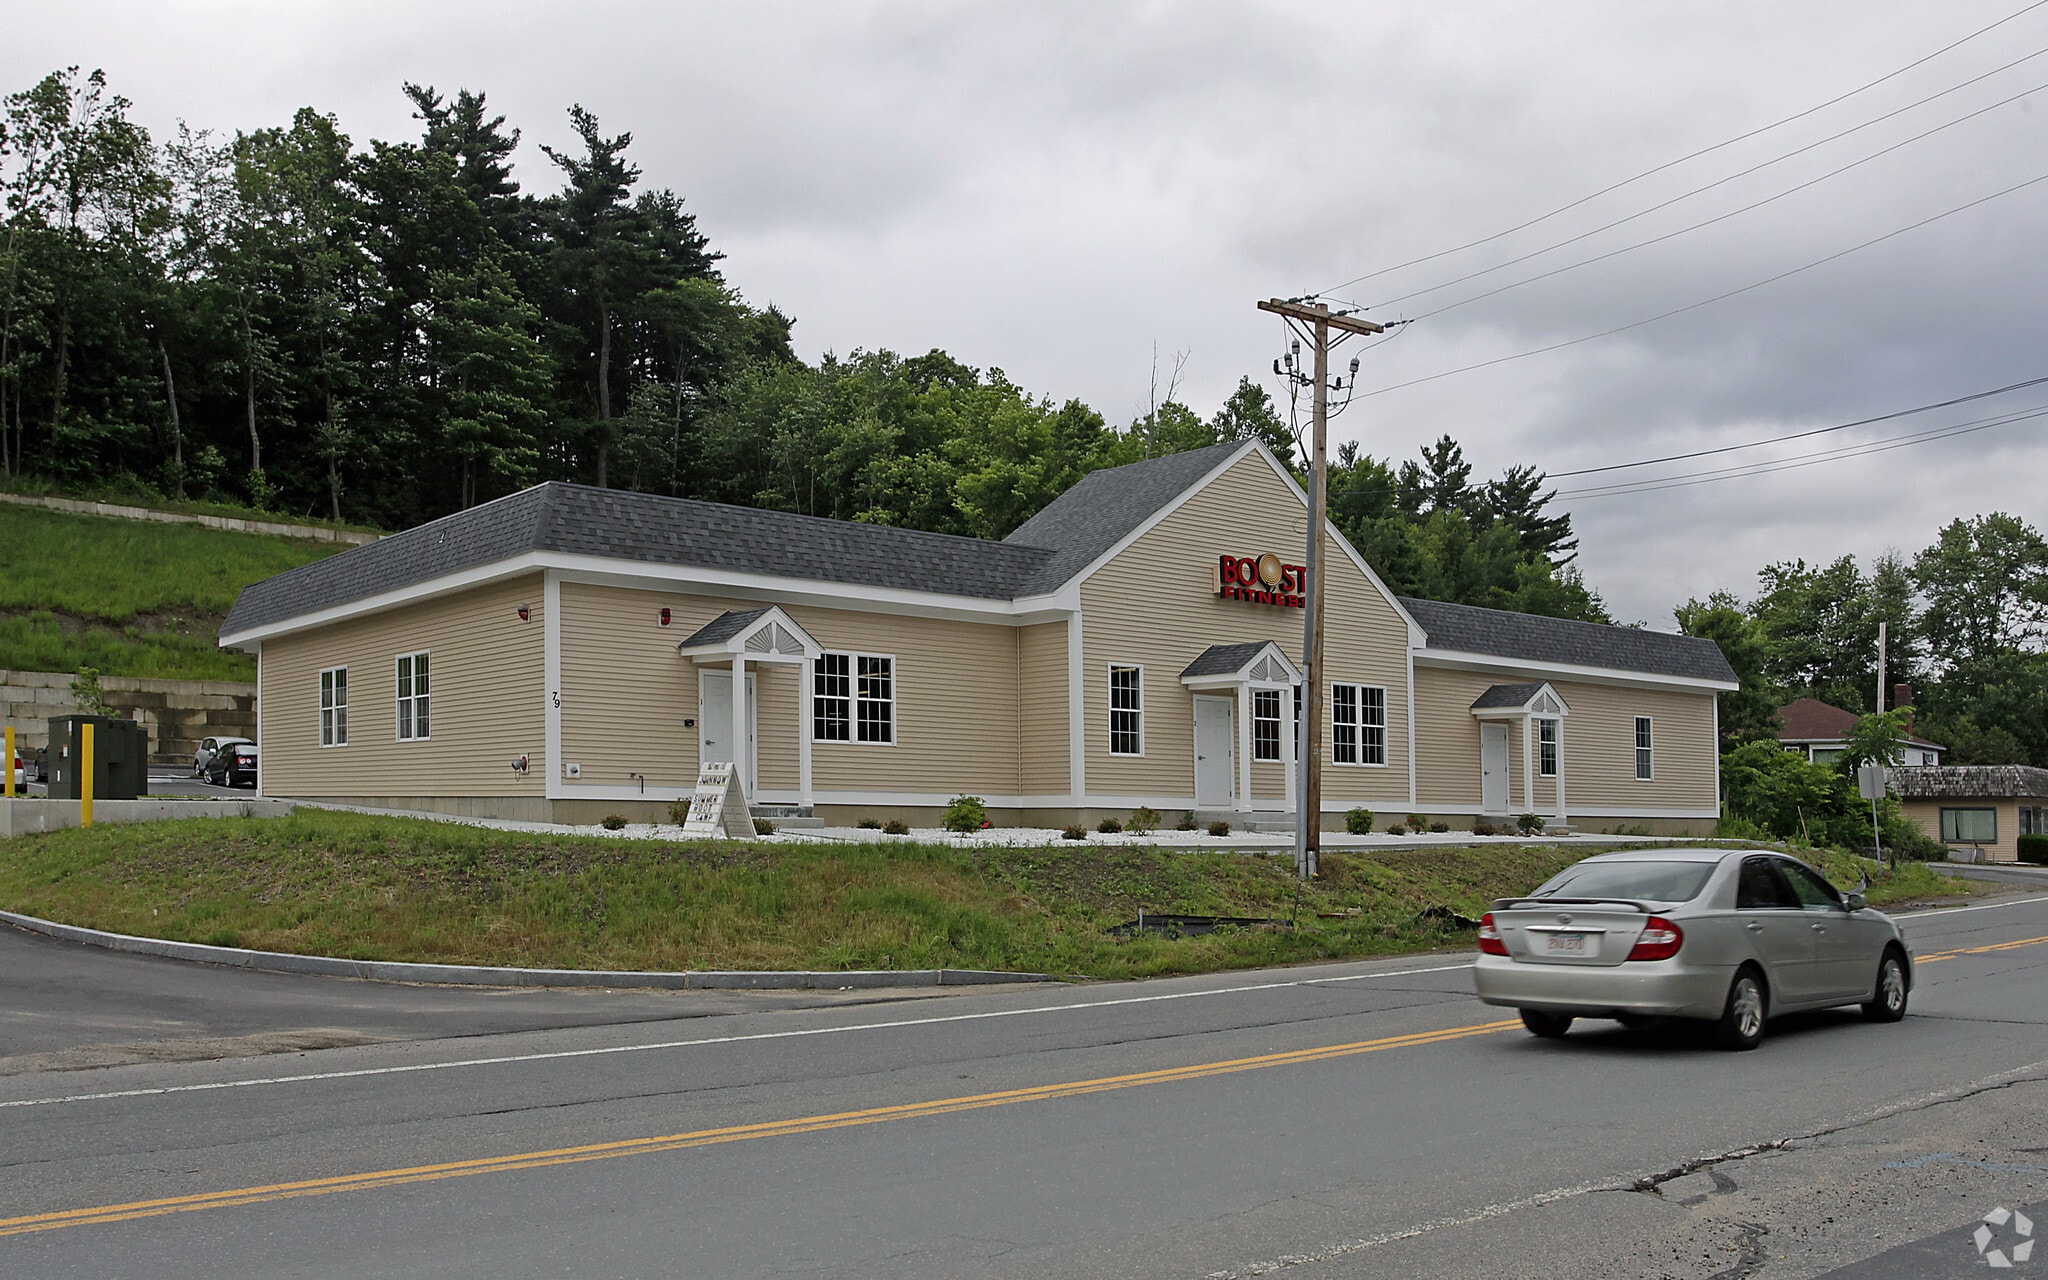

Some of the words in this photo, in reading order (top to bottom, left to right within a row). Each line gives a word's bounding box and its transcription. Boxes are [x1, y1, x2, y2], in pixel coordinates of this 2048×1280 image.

[1220, 552, 1307, 593] BOOST
[552, 691, 560, 708] 79
[694, 795, 718, 803] SUMMER
[694, 804, 713, 812] BOOT
[695, 813, 713, 821] CAMP
